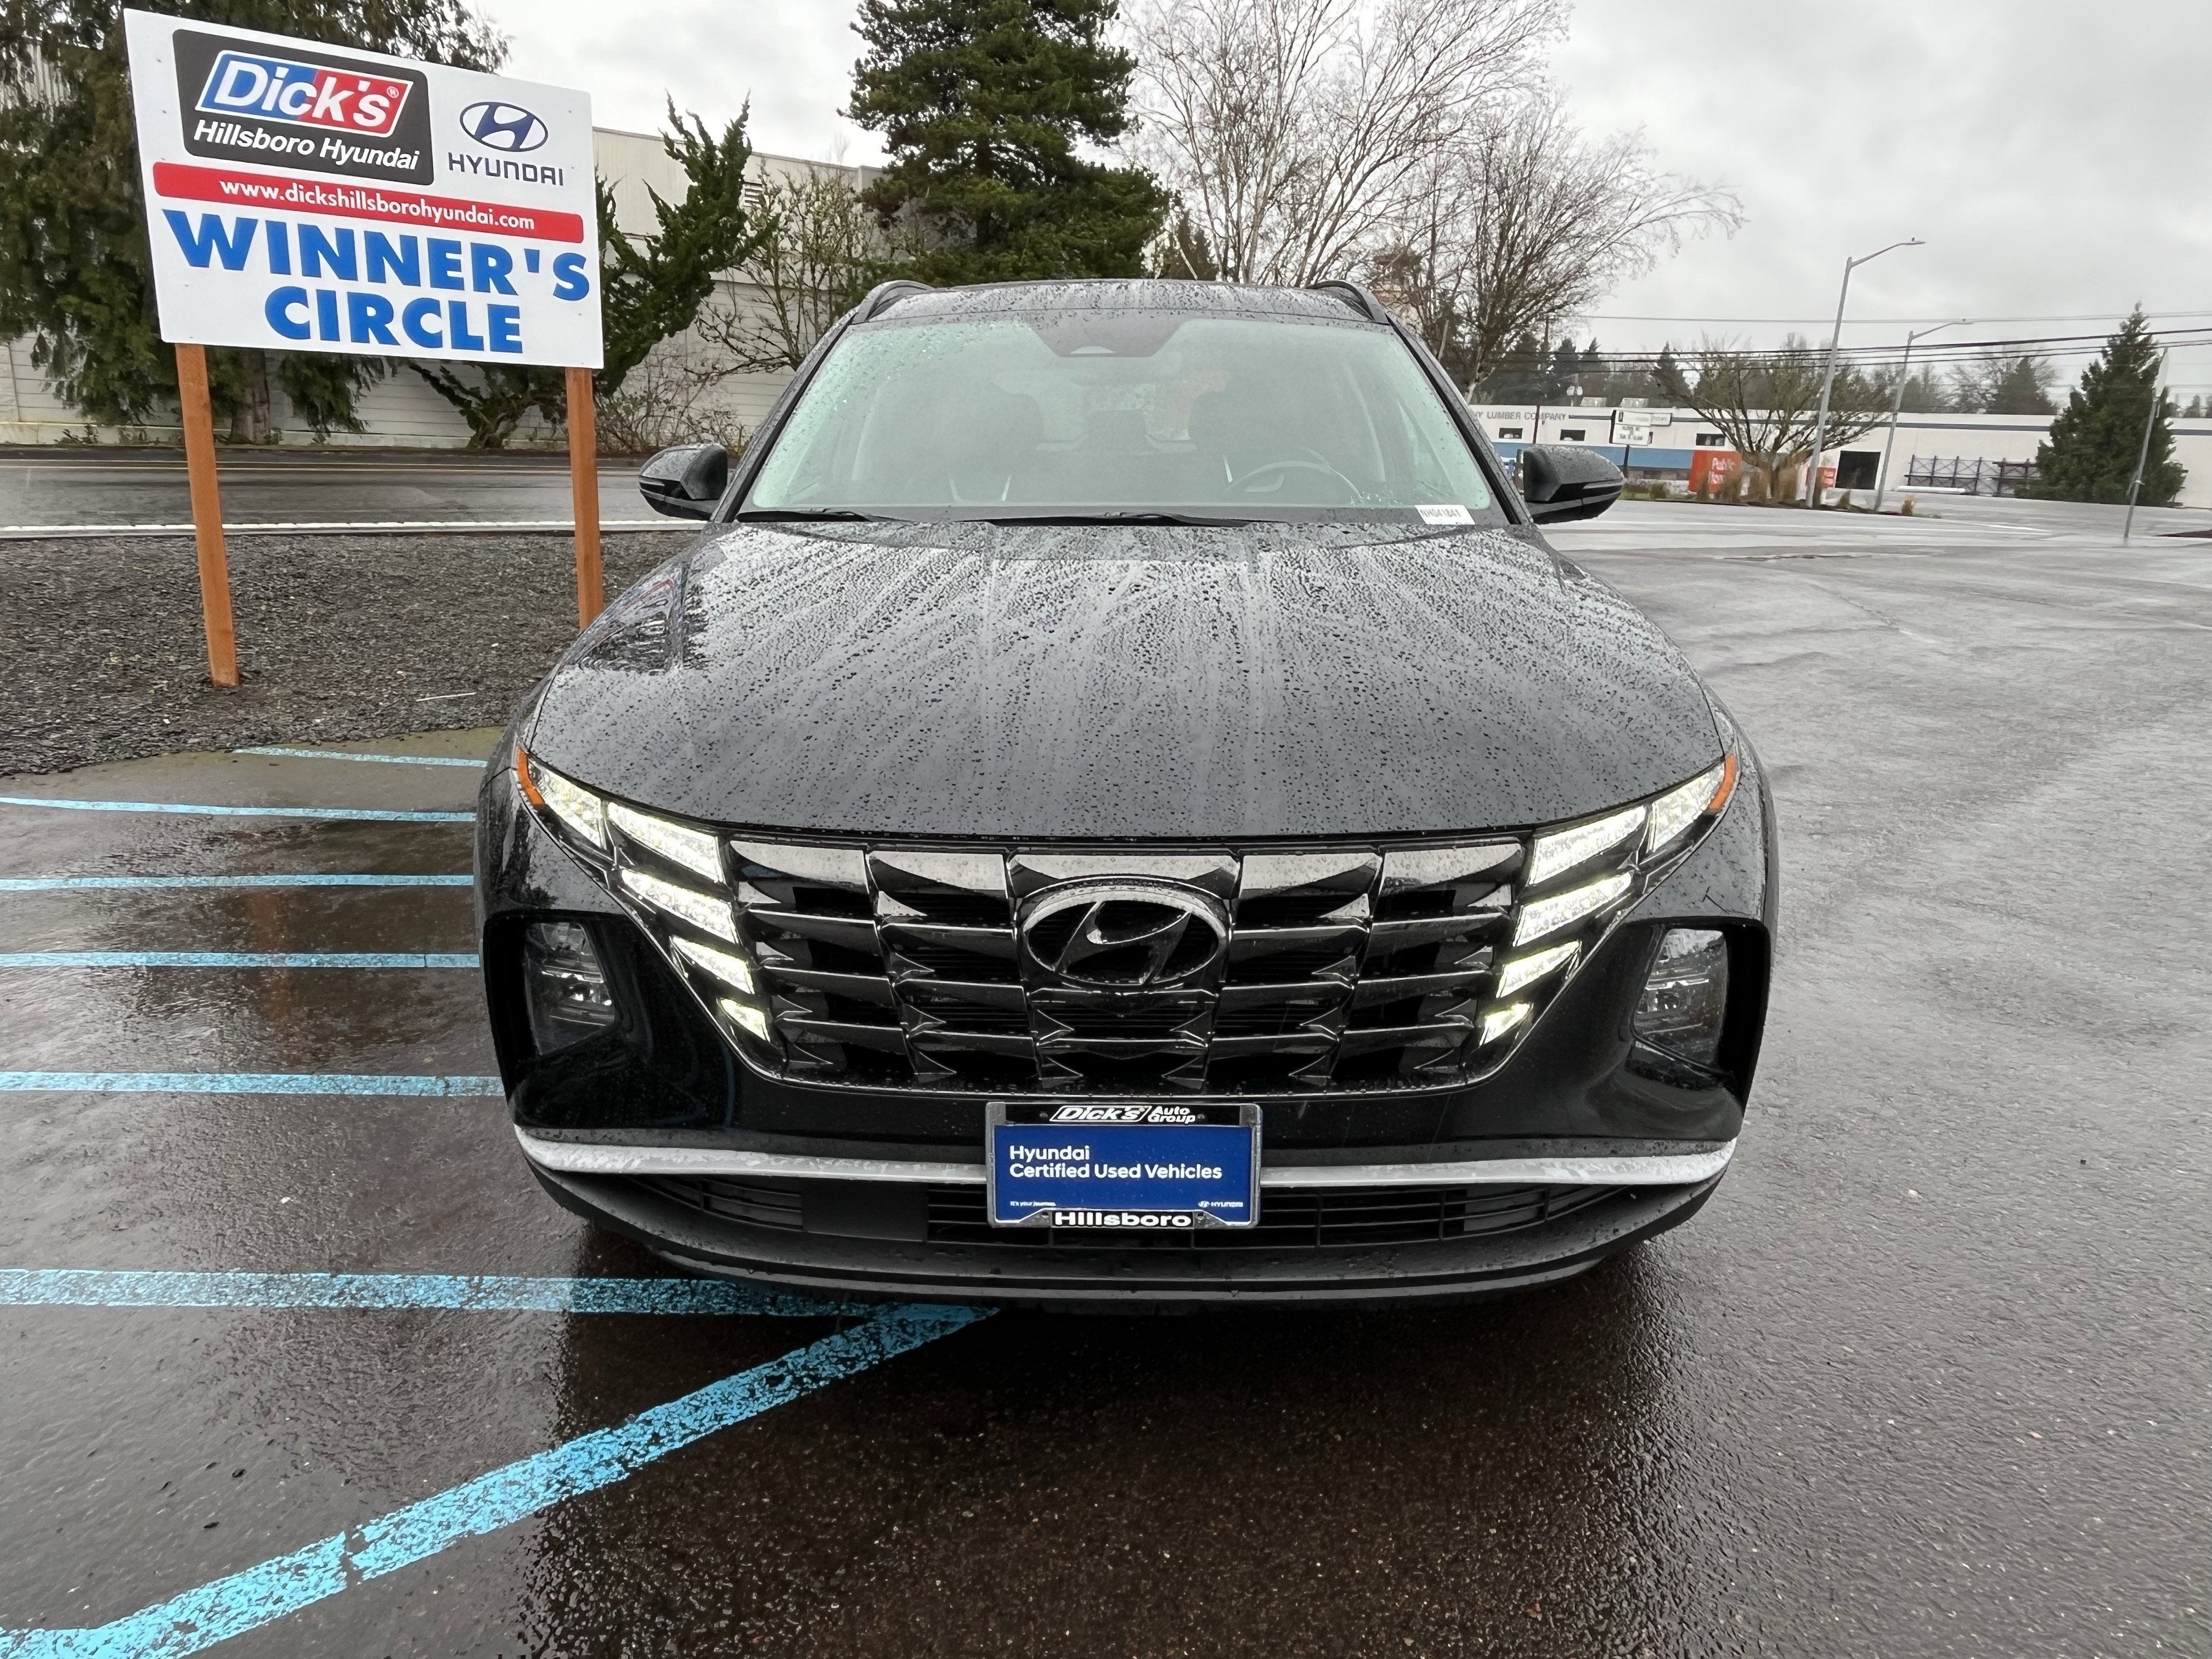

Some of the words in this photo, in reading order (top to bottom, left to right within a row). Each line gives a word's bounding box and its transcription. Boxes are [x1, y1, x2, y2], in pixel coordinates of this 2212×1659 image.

[215, 60, 390, 127] Dick's
[194, 119, 315, 155] Hillsboro
[319, 137, 420, 170] Hyundai
[448, 153, 563, 186] HYUNDAI
[220, 180, 535, 230] www.dickshillsborohyundai.com
[162, 209, 590, 301] WINNER'S
[264, 286, 522, 353] CIRCLE
[1487, 411, 1521, 420] LUMBER
[1148, 1113, 1195, 1124] Group
[1152, 1106, 1190, 1115] Auto
[1010, 1146, 1090, 1163] Hyundai
[1010, 1163, 1090, 1178] Certified
[1094, 1164, 1141, 1178] Used
[1144, 1164, 1222, 1179] Vehicles
[1055, 1211, 1191, 1227] Hillsboro
